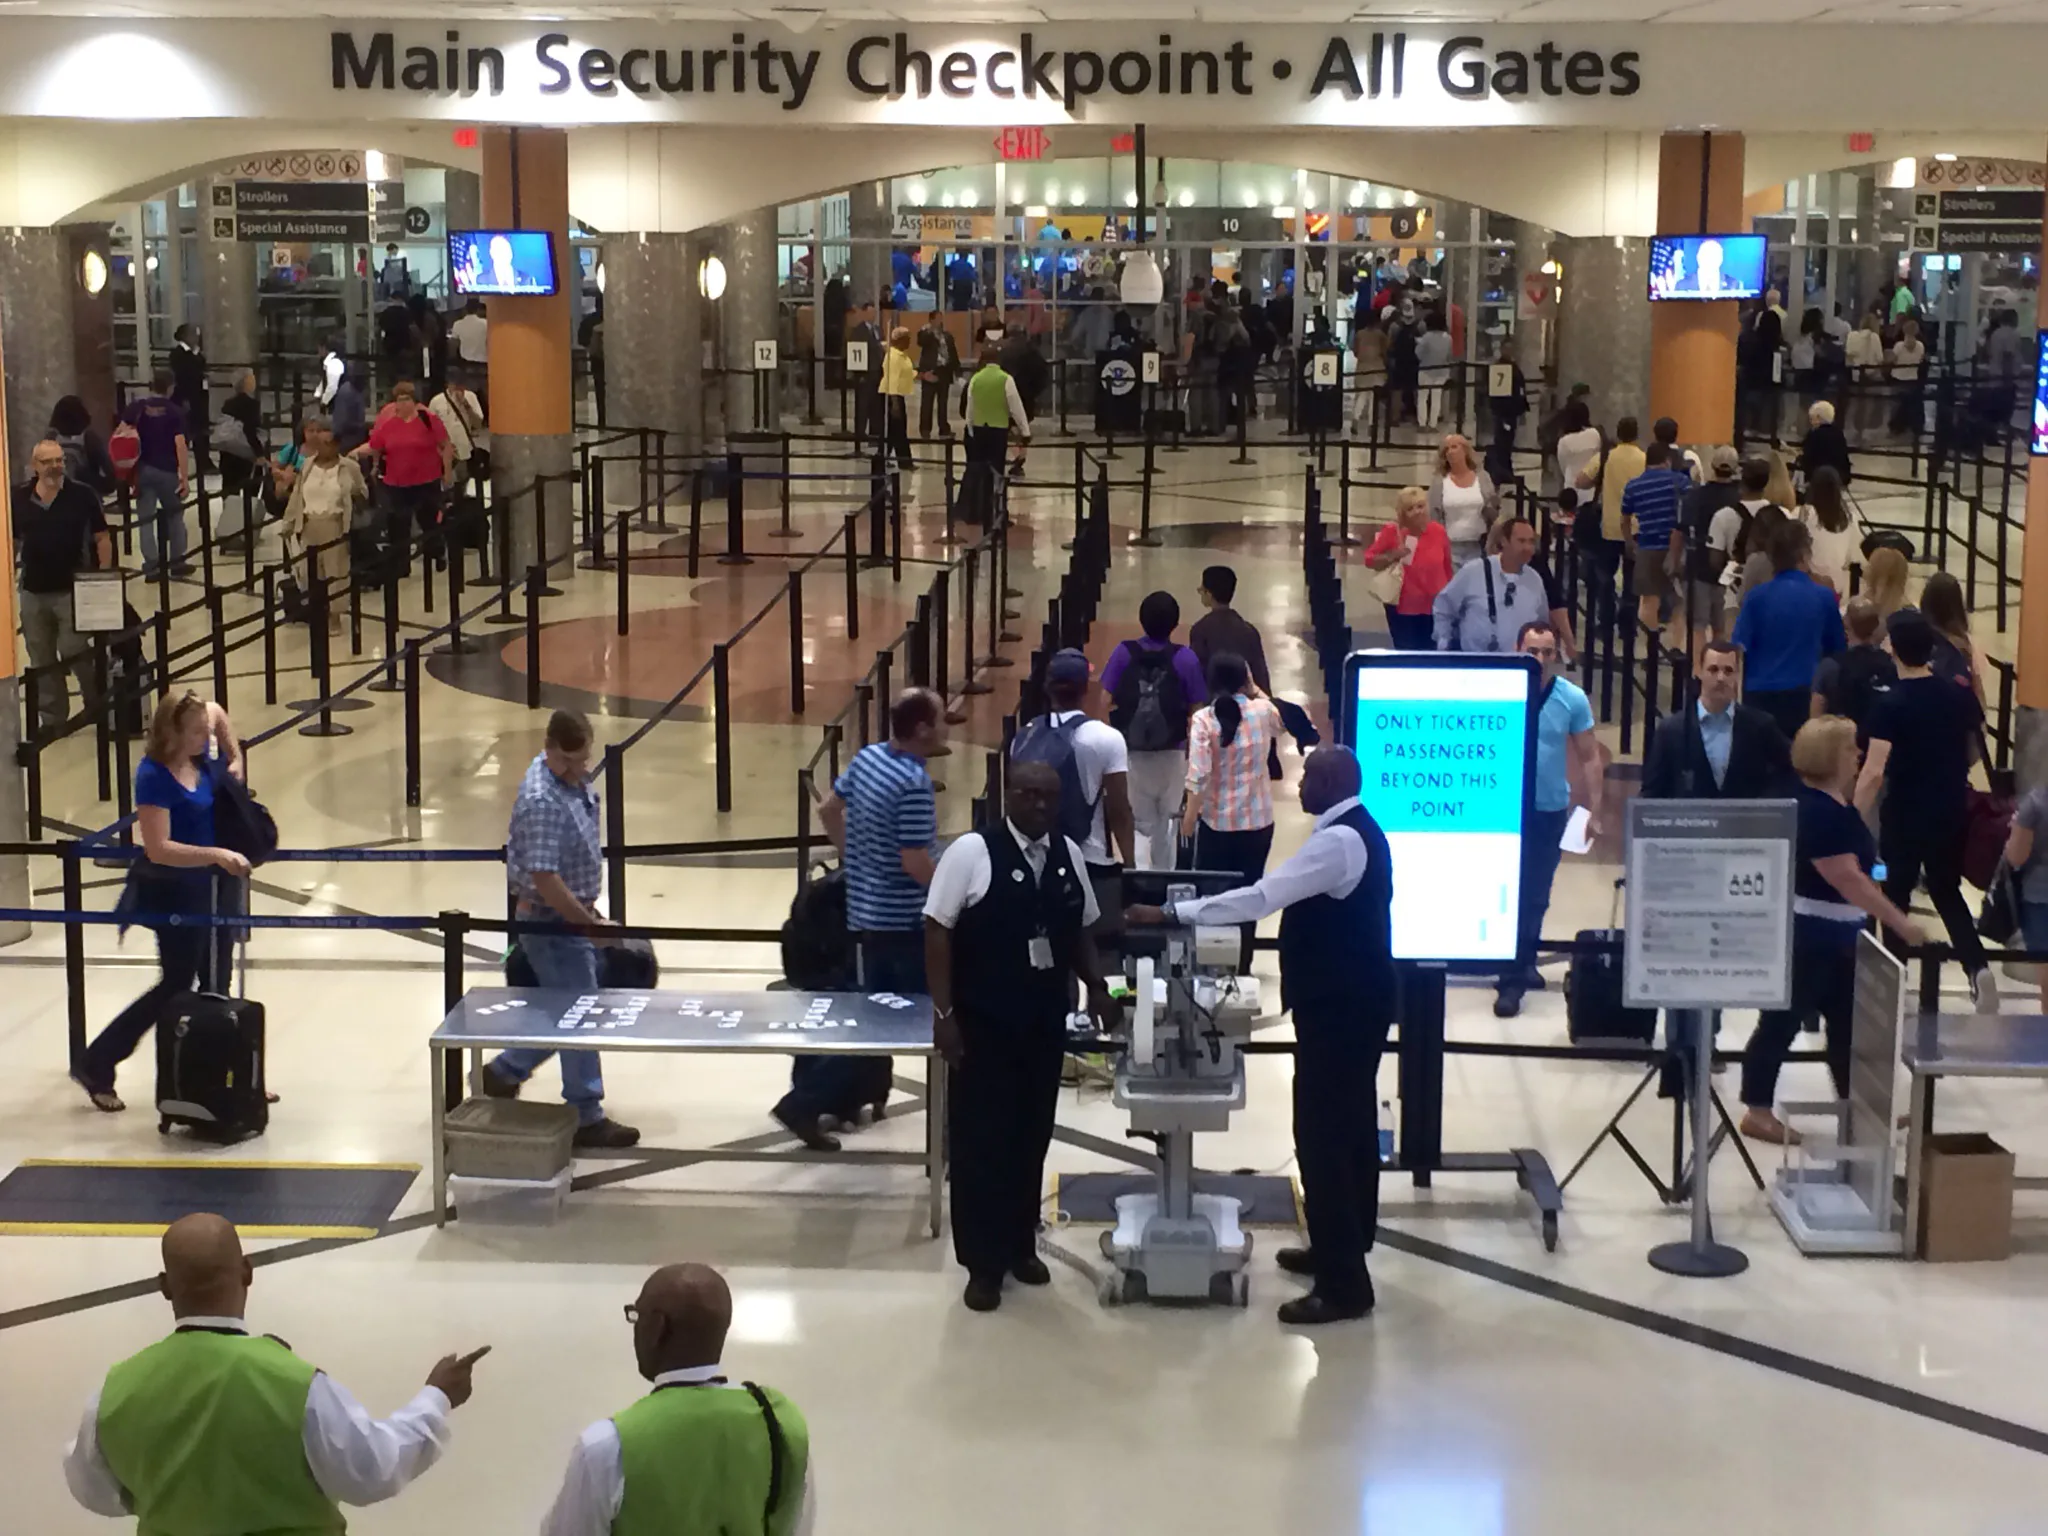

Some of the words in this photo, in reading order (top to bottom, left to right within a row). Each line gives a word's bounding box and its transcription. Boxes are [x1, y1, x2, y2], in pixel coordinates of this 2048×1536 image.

[331, 31, 505, 94] Main
[535, 32, 821, 110] Security
[846, 32, 1254, 111] Checkpoint
[1310, 32, 1407, 96] All
[1437, 35, 1641, 97] Gates
[1002, 126, 1045, 160] EXIT
[238, 190, 289, 203] Strollers
[1943, 198, 1996, 211] Strollers
[408, 214, 425, 227] 12
[899, 215, 972, 230] Assistance
[1222, 218, 1239, 232] 10
[1399, 218, 1409, 232] 9
[240, 221, 282, 236] Special
[285, 222, 348, 235] Assistance
[1941, 231, 1986, 246] Special
[759, 348, 772, 361] 12
[852, 349, 862, 362] 11
[1147, 361, 1155, 374] 9
[1321, 362, 1330, 376] 8
[1496, 372, 1505, 387] 7
[1375, 713, 1424, 731] ONLY
[1431, 714, 1507, 731] TICKETED
[1384, 743, 1497, 760] PASSENGERS
[1381, 772, 1454, 789] BEYOND
[1461, 773, 1498, 789] THIS
[1411, 801, 1465, 818] POINT
